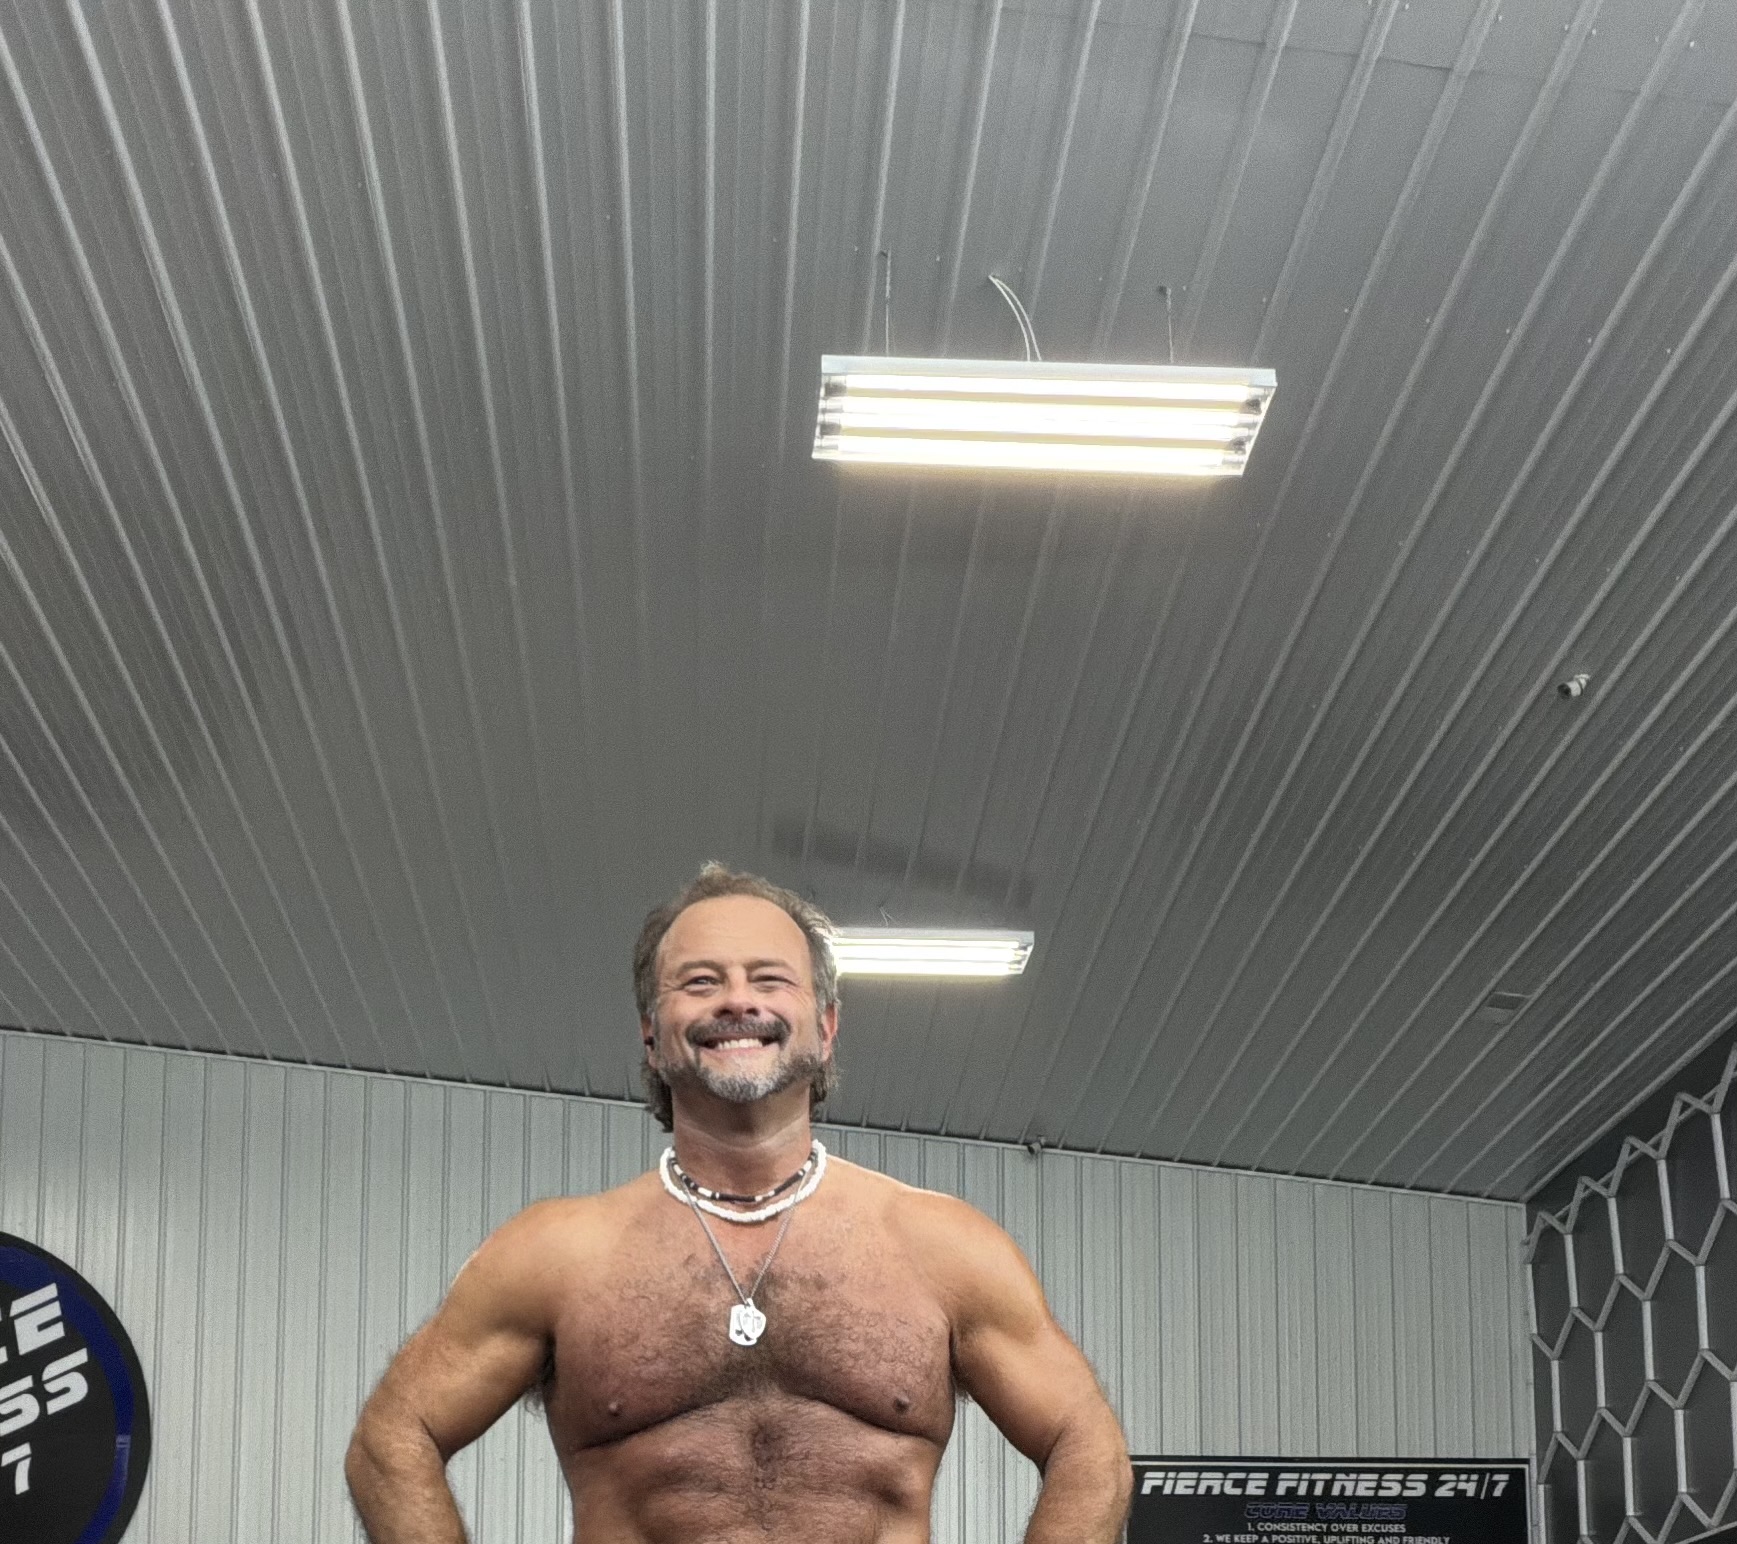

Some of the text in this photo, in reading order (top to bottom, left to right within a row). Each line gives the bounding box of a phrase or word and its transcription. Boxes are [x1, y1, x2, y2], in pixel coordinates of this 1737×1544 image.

[1140, 1471, 1510, 1500] FIERCE FITNESS 24/7
[1247, 1522, 1406, 1533] 1. CONSISTENCY OVER EXCUSES
[1202, 1534, 1213, 1543] 2.
[1215, 1534, 1231, 1543] WE
[1234, 1534, 1259, 1543] KEEP
[1261, 1535, 1269, 1543] A
[1272, 1535, 1321, 1544] POSITIVE,
[1323, 1535, 1375, 1544] UPLIFTING
[1378, 1536, 1400, 1544] AND
